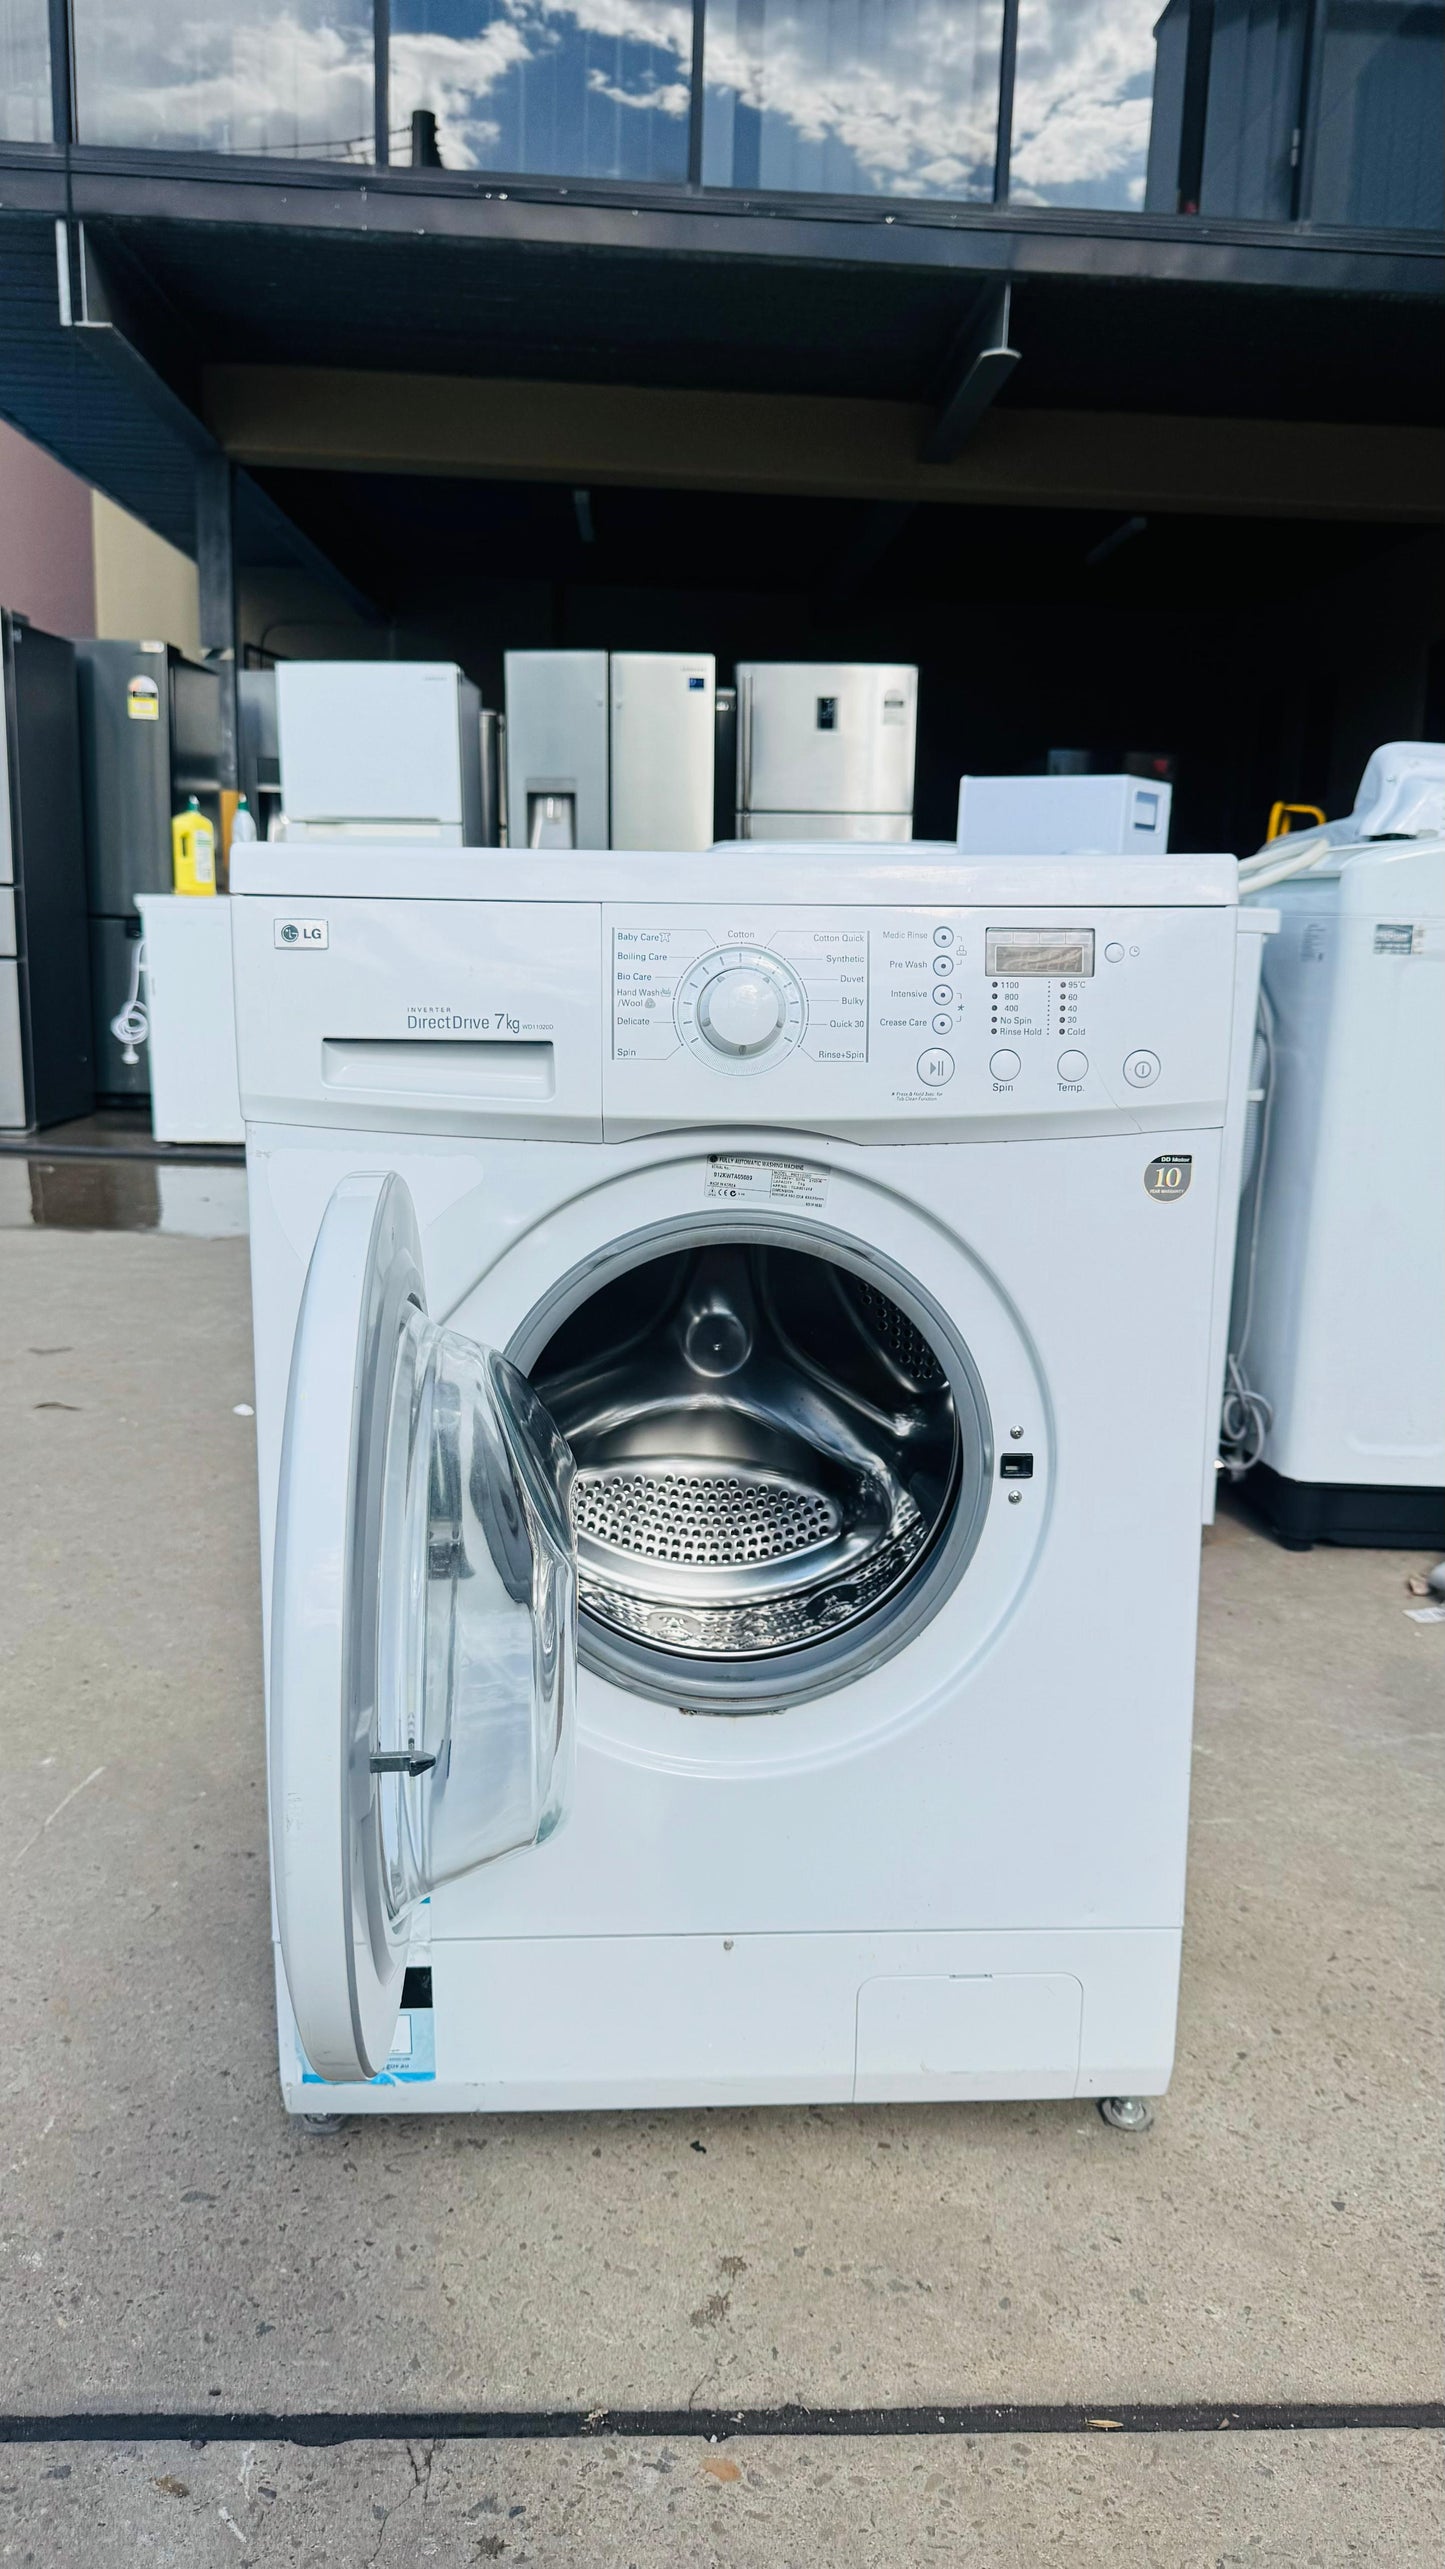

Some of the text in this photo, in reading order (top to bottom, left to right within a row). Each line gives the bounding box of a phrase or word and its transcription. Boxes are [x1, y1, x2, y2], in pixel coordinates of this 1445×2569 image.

[304, 928, 322, 940] LG
[617, 932, 660, 942] Baby Care
[728, 930, 754, 938] Cotton
[814, 934, 839, 942] Cotton
[617, 952, 646, 961] Boiling
[826, 954, 864, 964] Synthetic
[905, 960, 928, 968] Wash
[842, 997, 864, 1005] Bulky
[617, 1017, 650, 1025] Delicate
[1014, 1017, 1032, 1025] Spin
[617, 1048, 636, 1057] Spin
[818, 1050, 864, 1059] Rinse+Spin
[992, 1082, 1014, 1092] Spin
[1057, 1083, 1085, 1092] Temp.
[1154, 1167, 1182, 1187] 10
